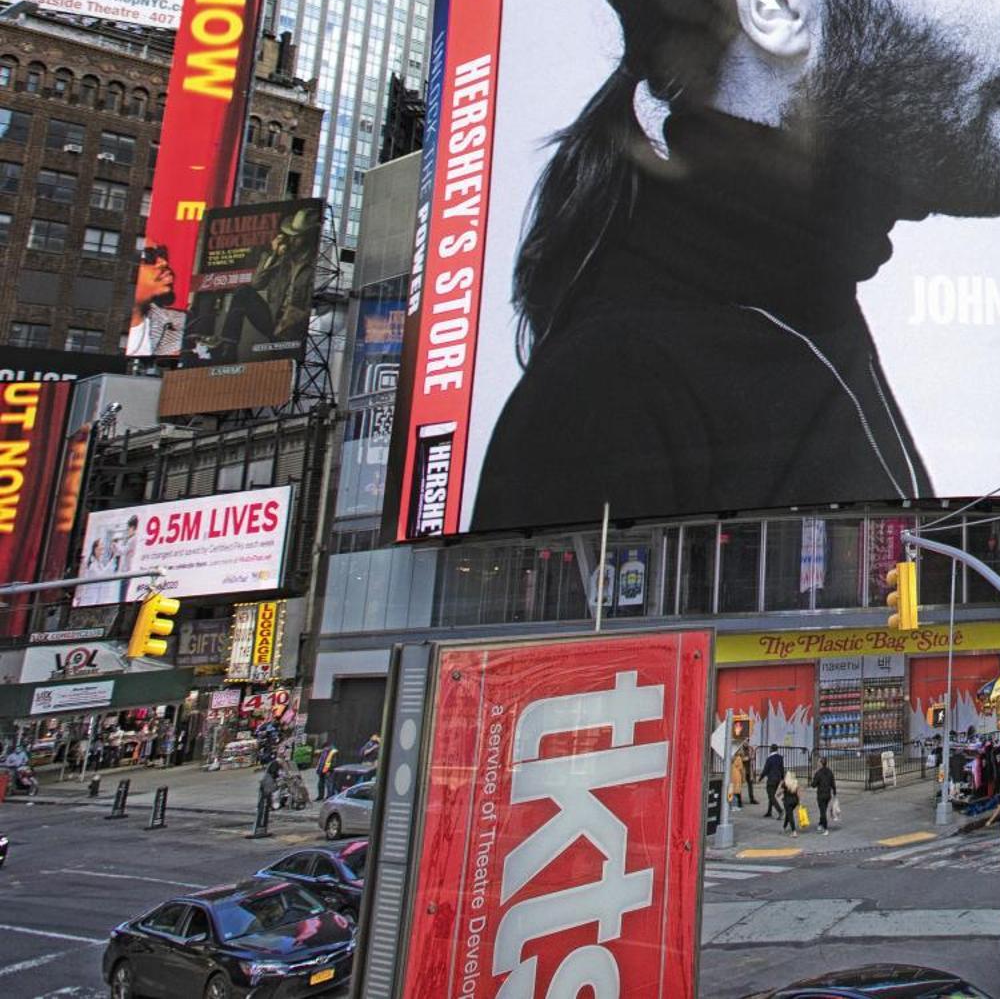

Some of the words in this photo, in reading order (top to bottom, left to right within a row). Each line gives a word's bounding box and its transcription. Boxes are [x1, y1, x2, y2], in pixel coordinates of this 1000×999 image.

[87, 0, 140, 20] Theatre
[149, 11, 176, 25] 407
[426, 31, 446, 134] UNLOCK
[420, 139, 436, 198] THE
[438, 54, 492, 259] HERSHEY'S
[408, 203, 430, 316] POWER
[424, 271, 474, 396] STORE
[0, 381, 42, 432] UT
[421, 444, 452, 537] HERSHE
[145, 510, 202, 547] 9.5M
[208, 500, 280, 539] LIVES
[190, 632, 226, 654] GIFTS
[257, 603, 274, 663] LUGGAGE
[760, 636, 796, 658] The
[797, 633, 864, 653] Plastic
[866, 631, 908, 652] Bag
[491, 705, 504, 716] a
[483, 721, 503, 796] service
[482, 801, 498, 822] of
[471, 825, 497, 910] Theatre
